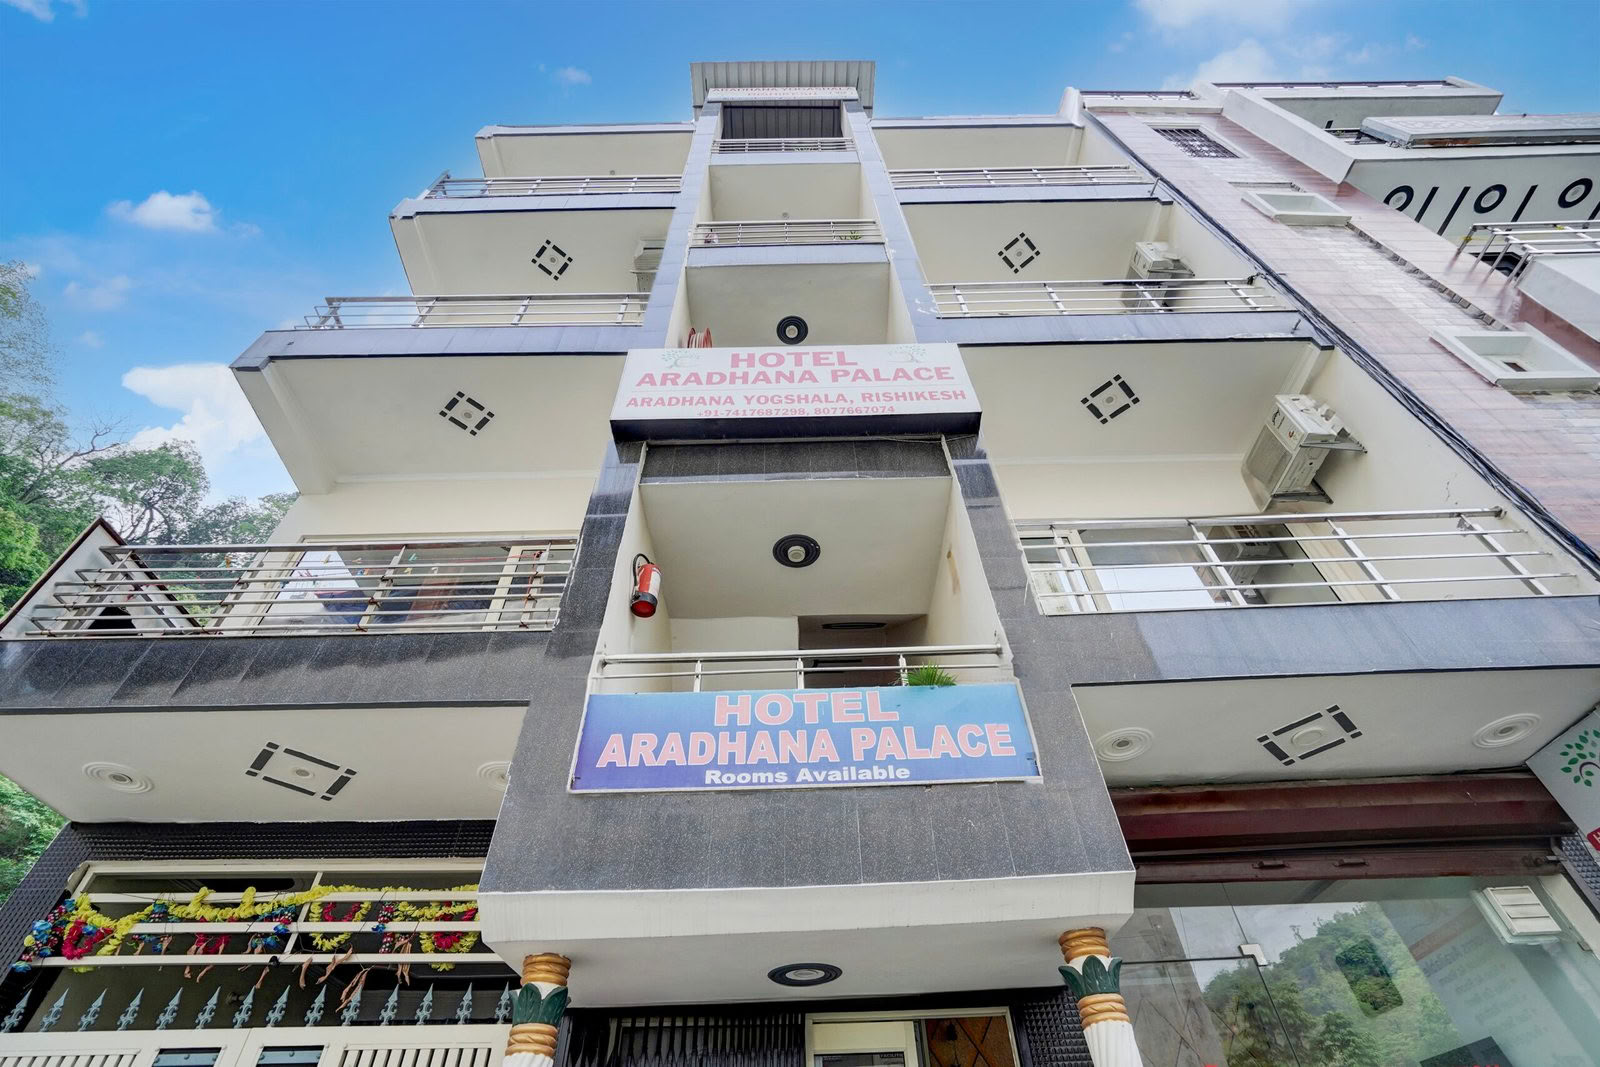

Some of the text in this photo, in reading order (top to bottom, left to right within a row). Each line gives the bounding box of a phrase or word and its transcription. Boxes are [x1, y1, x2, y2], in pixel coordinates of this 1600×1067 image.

[730, 351, 858, 369] HOTEL
[635, 366, 954, 387] ARADHANA PALACE
[625, 390, 967, 408] ARADHANA YOGSHALA, RISHIKESH
[814, 405, 896, 416] 8077667074
[714, 691, 900, 726] HOTEL
[596, 724, 1016, 768] ARADHANA PALACE
[704, 764, 911, 786] Rooms Available
